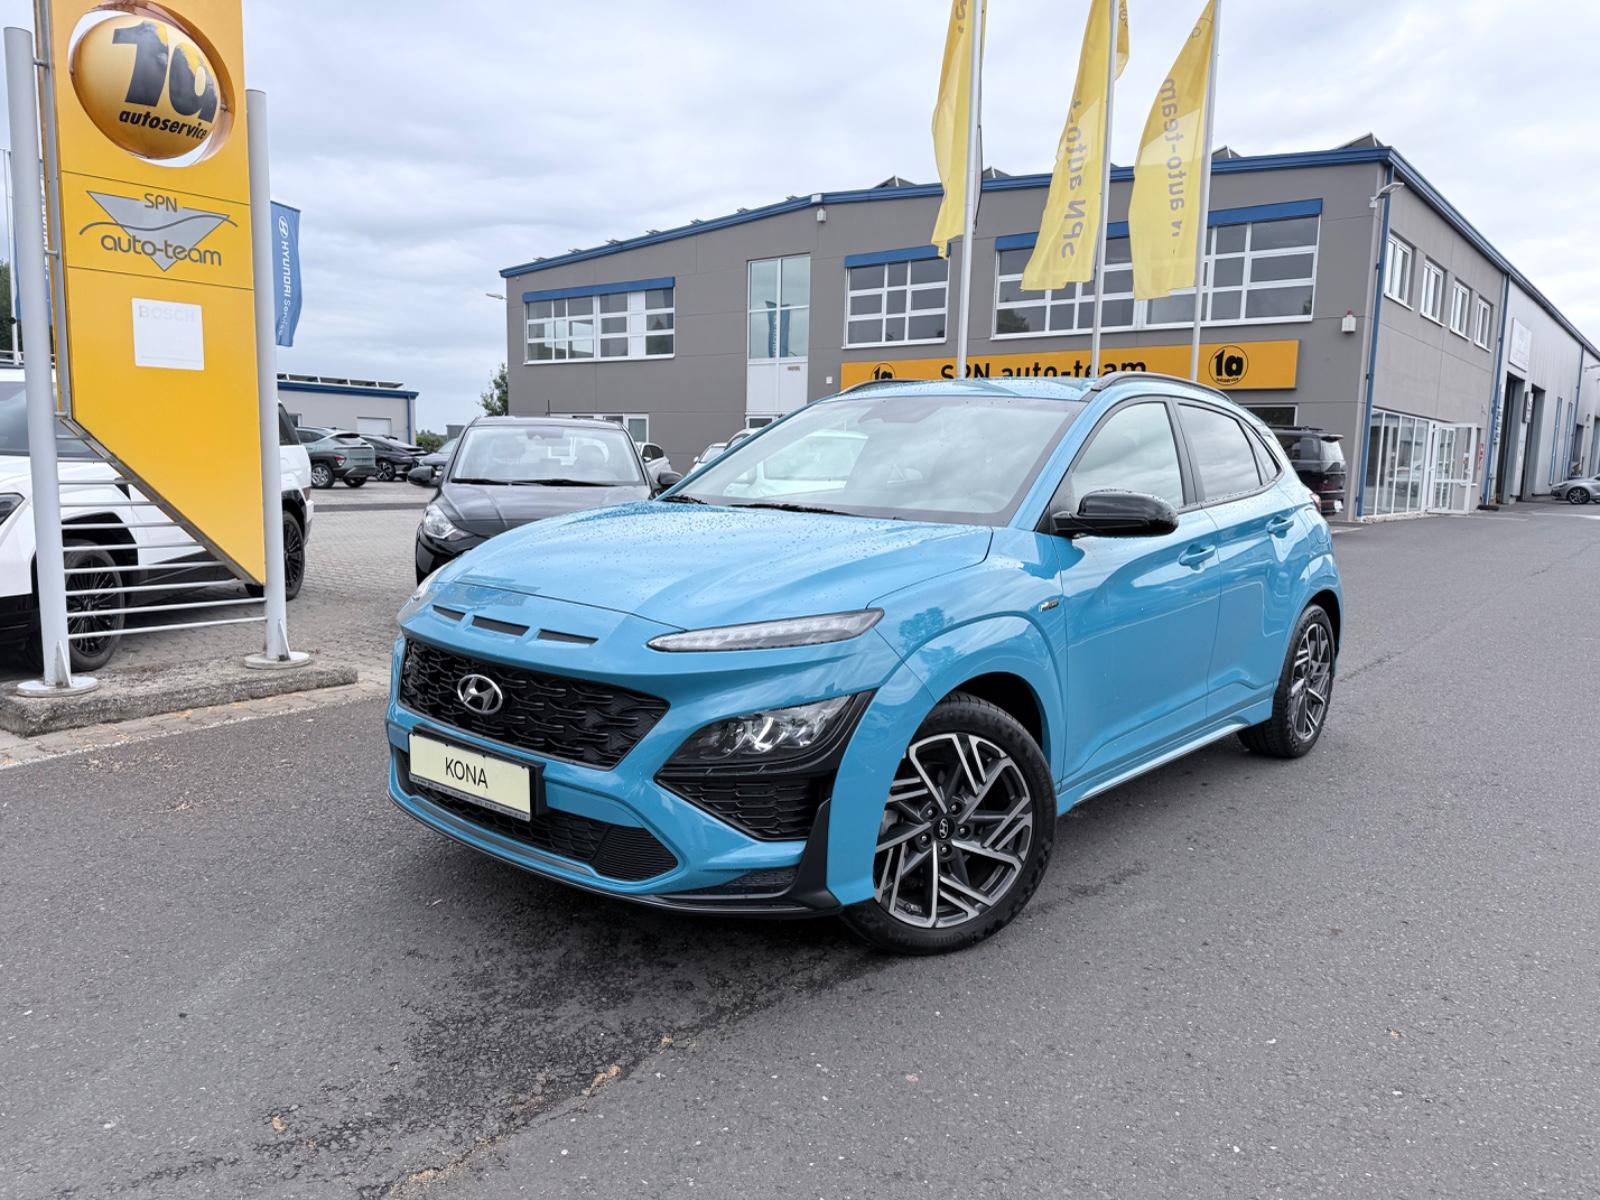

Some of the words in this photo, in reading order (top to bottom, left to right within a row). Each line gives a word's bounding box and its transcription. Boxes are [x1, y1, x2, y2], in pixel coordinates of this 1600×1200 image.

[119, 110, 208, 140] autoservice
[144, 193, 178, 212] SPN
[100, 234, 222, 266] auto-team
[281, 240, 292, 297] HYUNDAI
[138, 304, 196, 322] BOSCH
[1215, 349, 1244, 377] 1a
[445, 756, 489, 789] KONA
